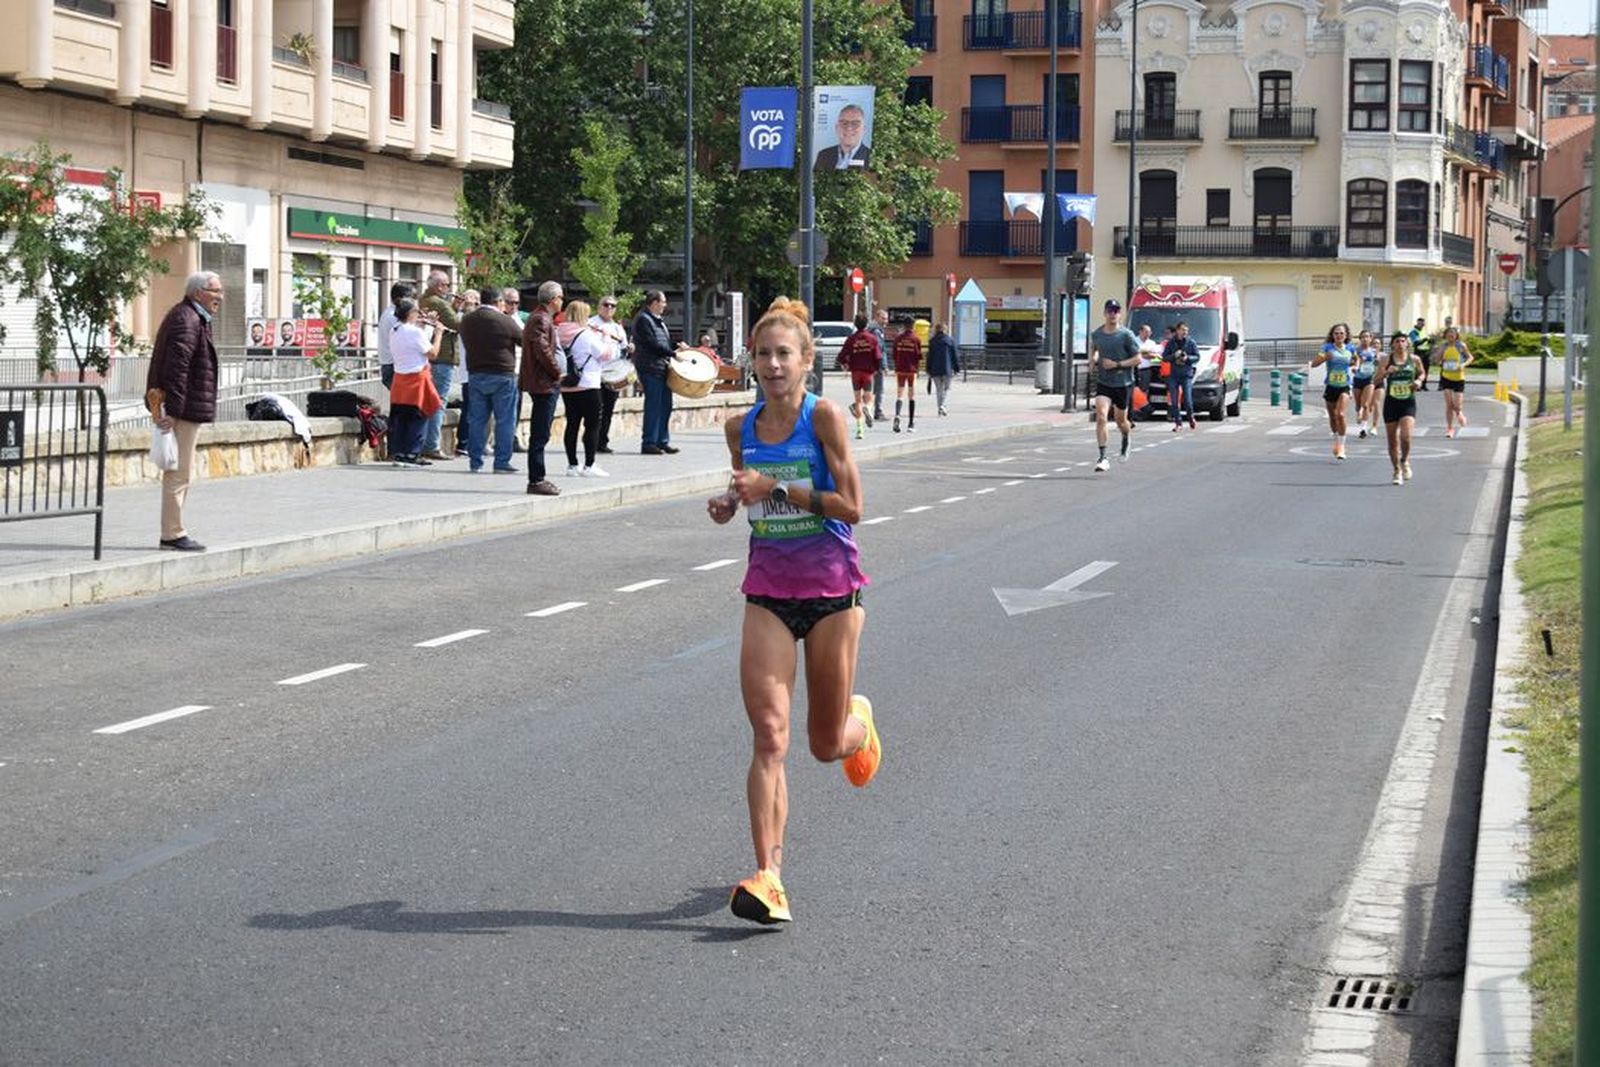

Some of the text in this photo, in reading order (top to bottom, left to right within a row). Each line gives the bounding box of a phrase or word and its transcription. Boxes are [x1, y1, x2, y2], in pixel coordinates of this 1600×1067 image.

[750, 109, 784, 121] VOTA
[768, 521, 818, 533] CAJA RURAL
